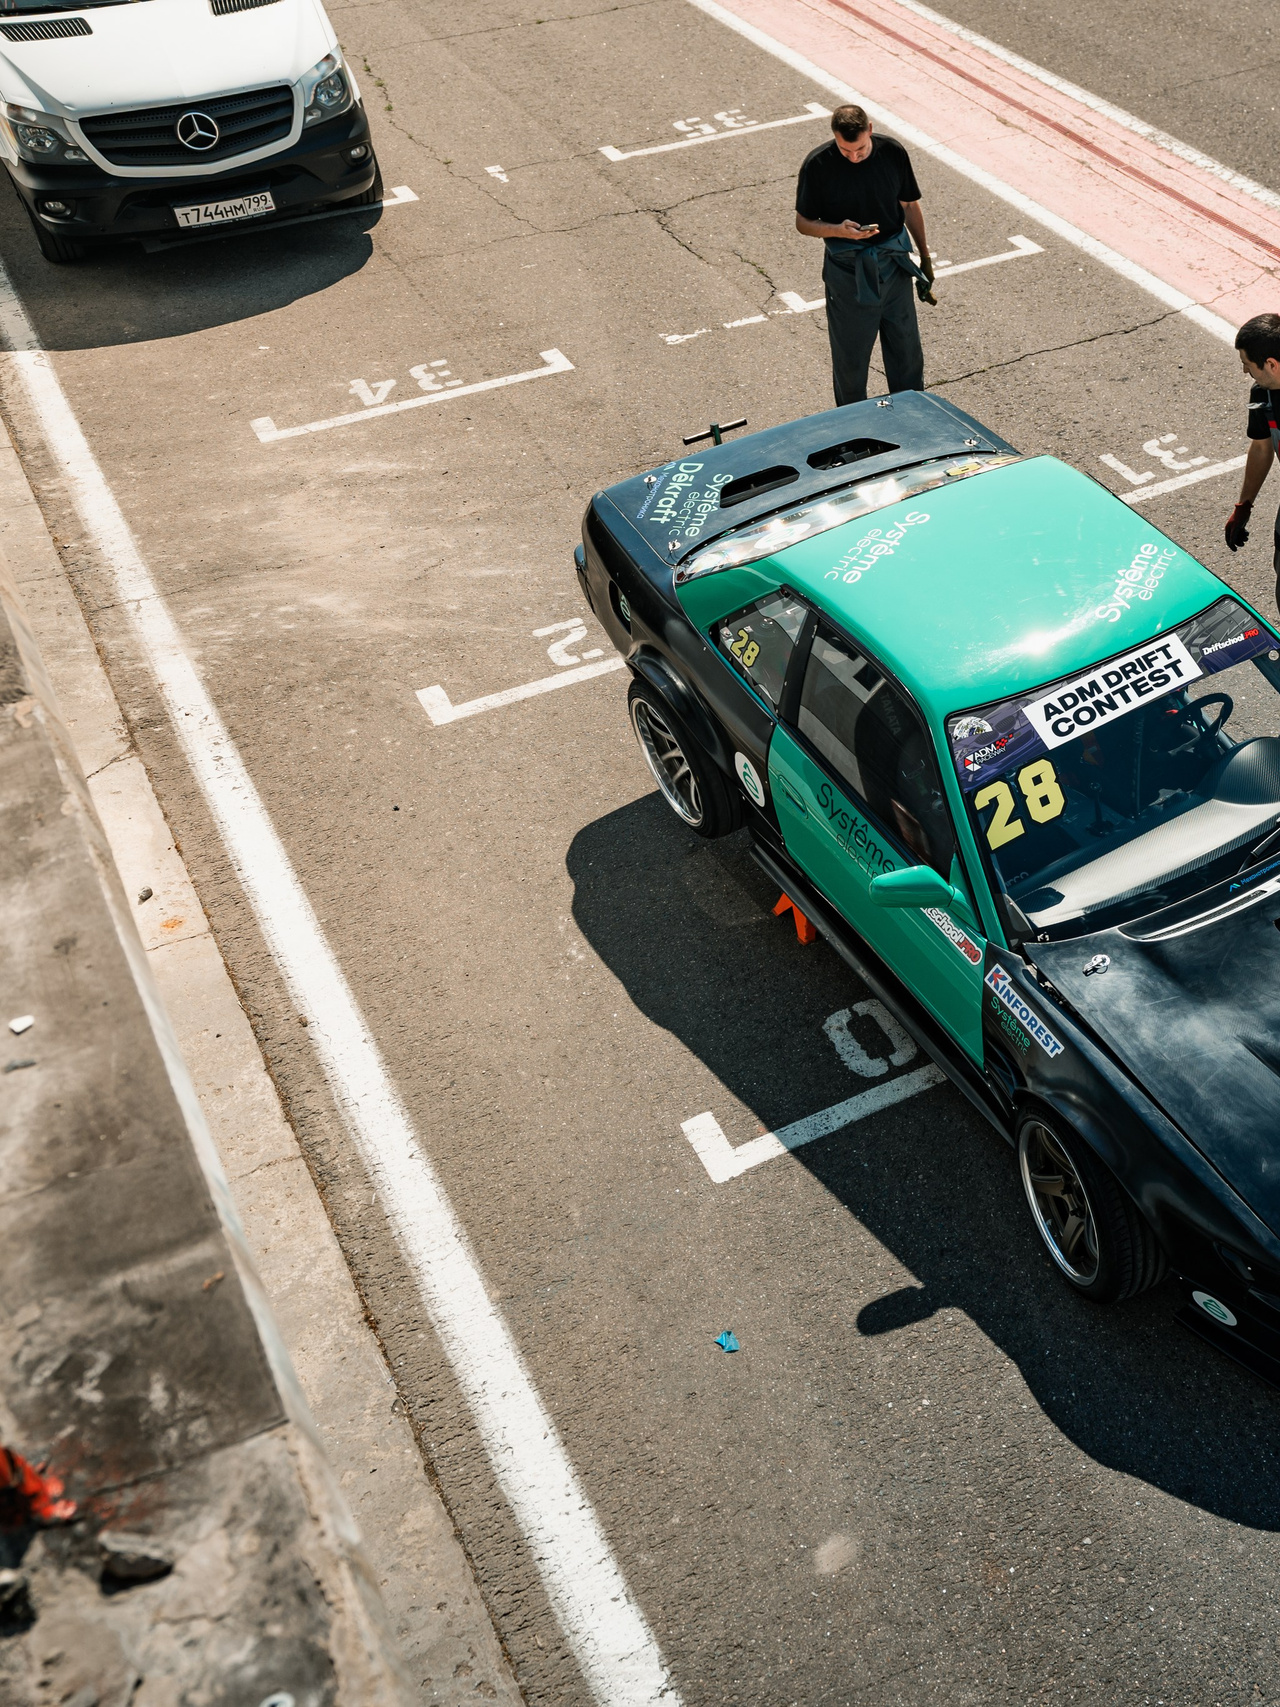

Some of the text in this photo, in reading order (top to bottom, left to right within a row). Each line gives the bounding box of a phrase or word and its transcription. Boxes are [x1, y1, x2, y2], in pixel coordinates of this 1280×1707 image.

[672, 109, 759, 138] 35
[244, 195, 268, 209] 799
[348, 359, 464, 406] 34
[1100, 433, 1210, 486] 31
[668, 491, 700, 536] electric
[825, 527, 883, 582] electric
[842, 511, 931, 584] Systême
[1096, 542, 1159, 623] Systême
[1138, 548, 1177, 602] electric
[729, 627, 761, 668] 28
[1043, 643, 1173, 722] ADM DRIFT
[1050, 659, 1185, 739] CONTEST
[974, 743, 997, 760] ADM
[975, 746, 1007, 765] RACEWAY
[973, 758, 1067, 851] 28
[986, 966, 1062, 1055] KINFOREST
[990, 996, 1031, 1048] Systême
[1000, 1021, 1028, 1056] electric
